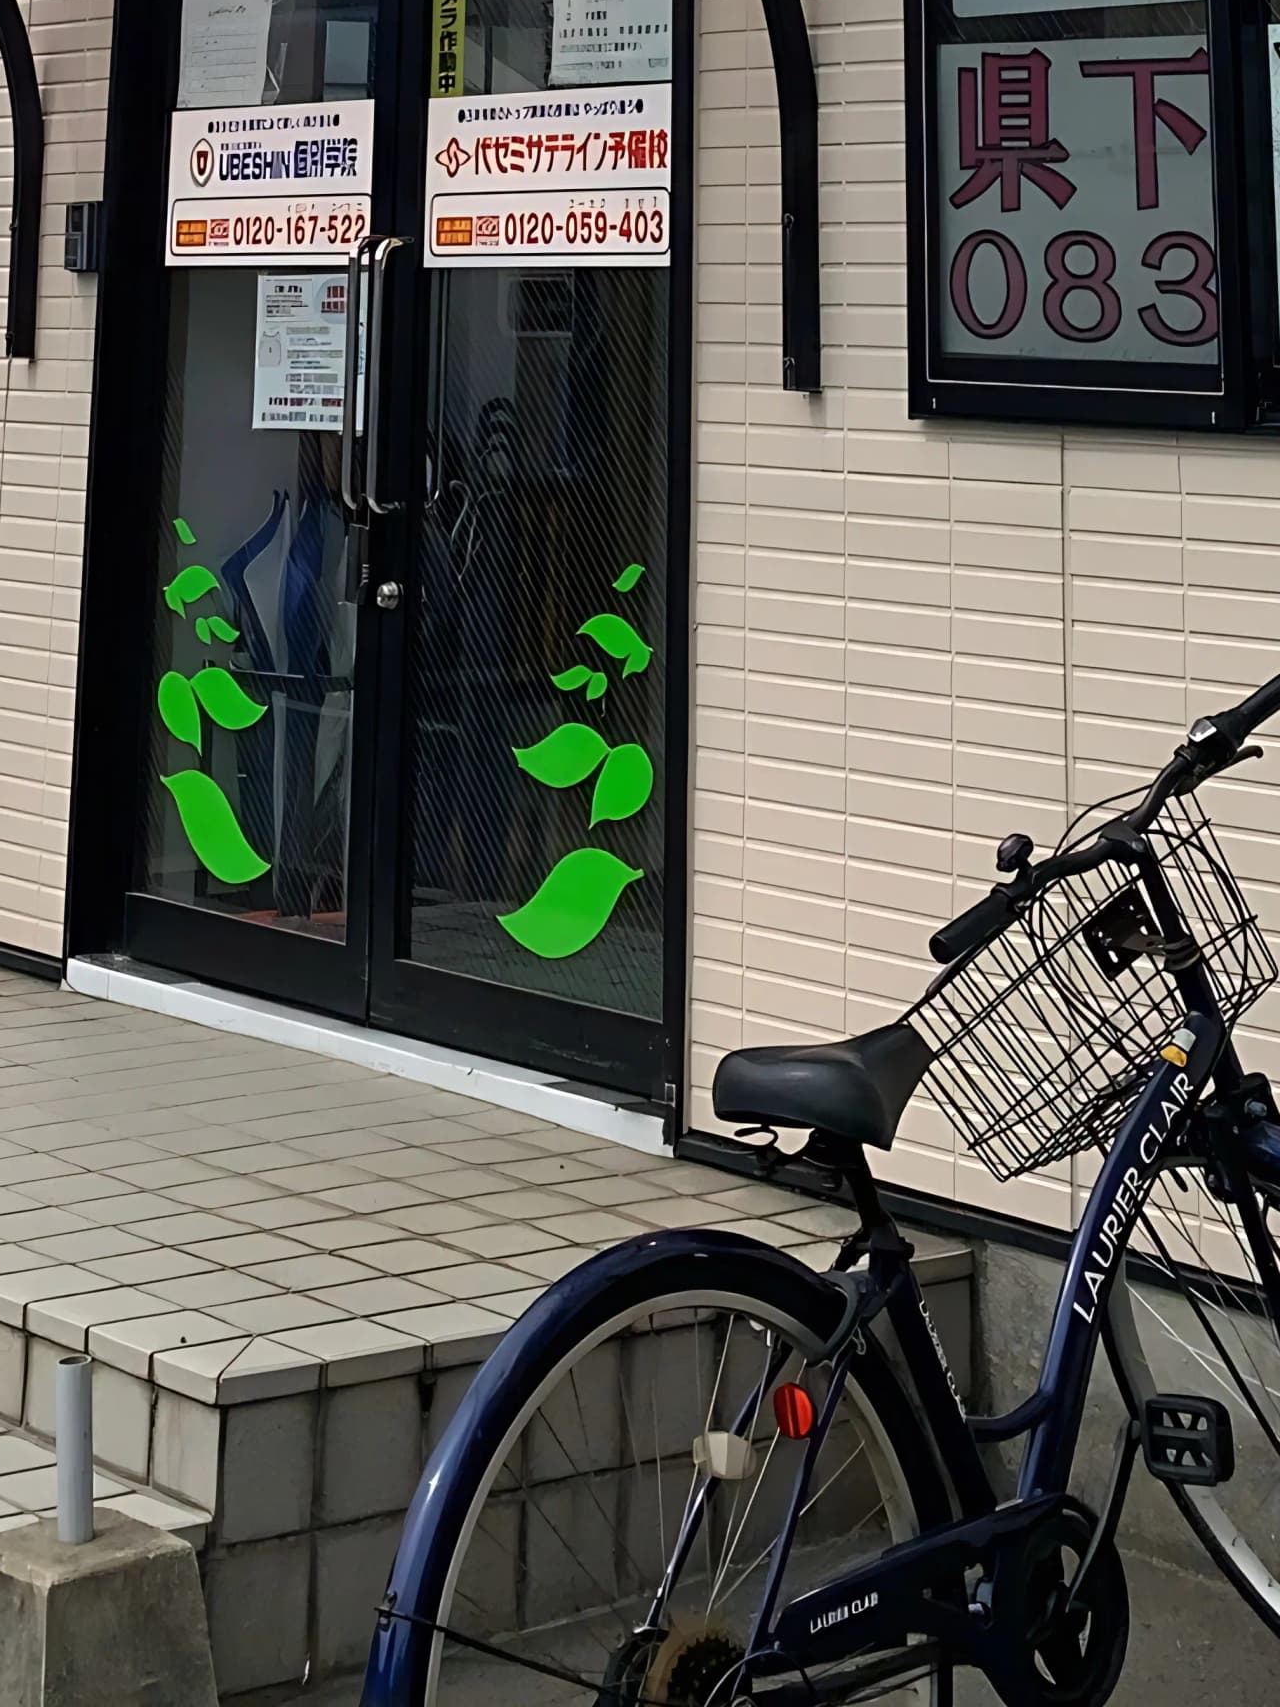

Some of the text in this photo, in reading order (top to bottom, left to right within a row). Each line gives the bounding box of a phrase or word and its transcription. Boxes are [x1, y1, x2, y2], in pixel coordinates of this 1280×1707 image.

[475, 129, 668, 175] 代ゼミサテライン予備校
[949, 47, 1210, 212] 県下
[505, 210, 663, 245] 0120-059-403
[950, 229, 1218, 347] 083
[1073, 1073, 1193, 1324] LAURIER CLAIR
